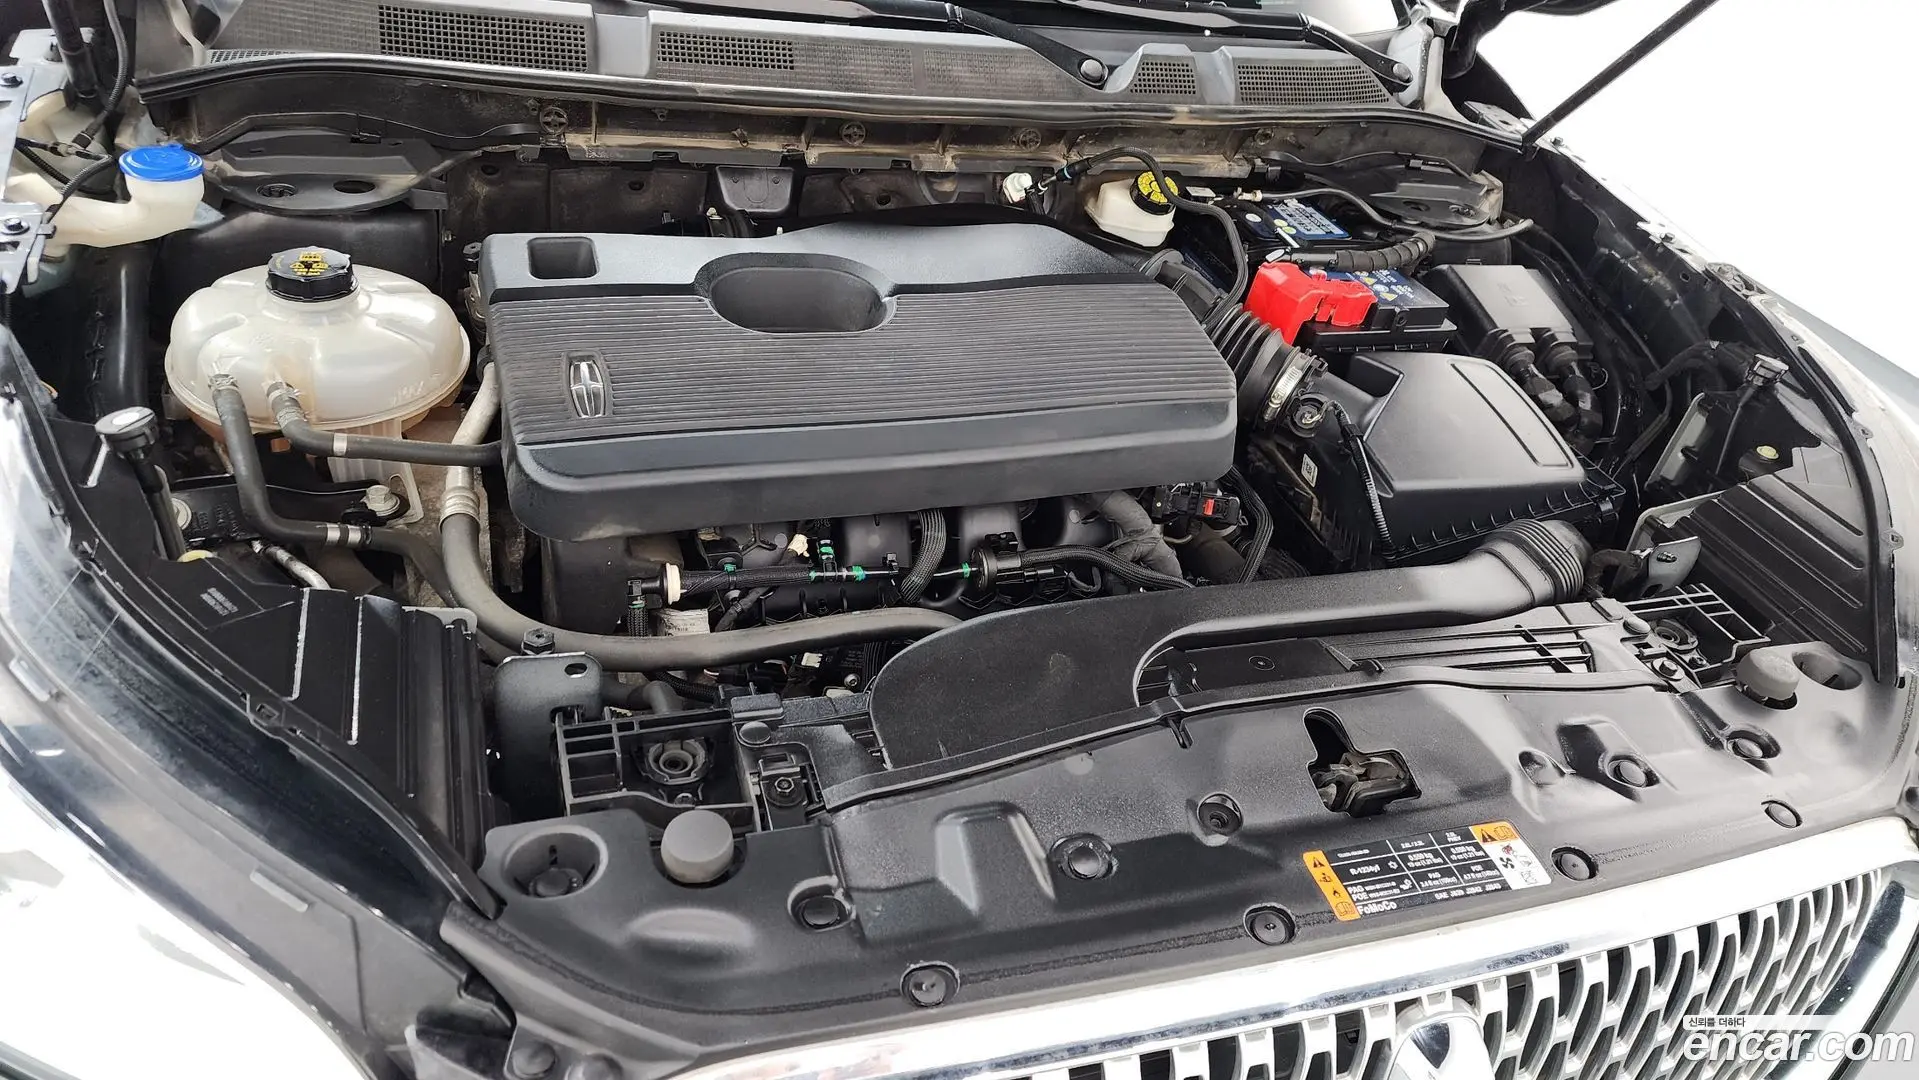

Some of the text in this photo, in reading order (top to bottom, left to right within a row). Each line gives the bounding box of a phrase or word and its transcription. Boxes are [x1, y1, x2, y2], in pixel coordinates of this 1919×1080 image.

[1347, 885, 1364, 894] PAG
[1351, 892, 1369, 901] POE
[1357, 901, 1397, 915] FoMoCo
